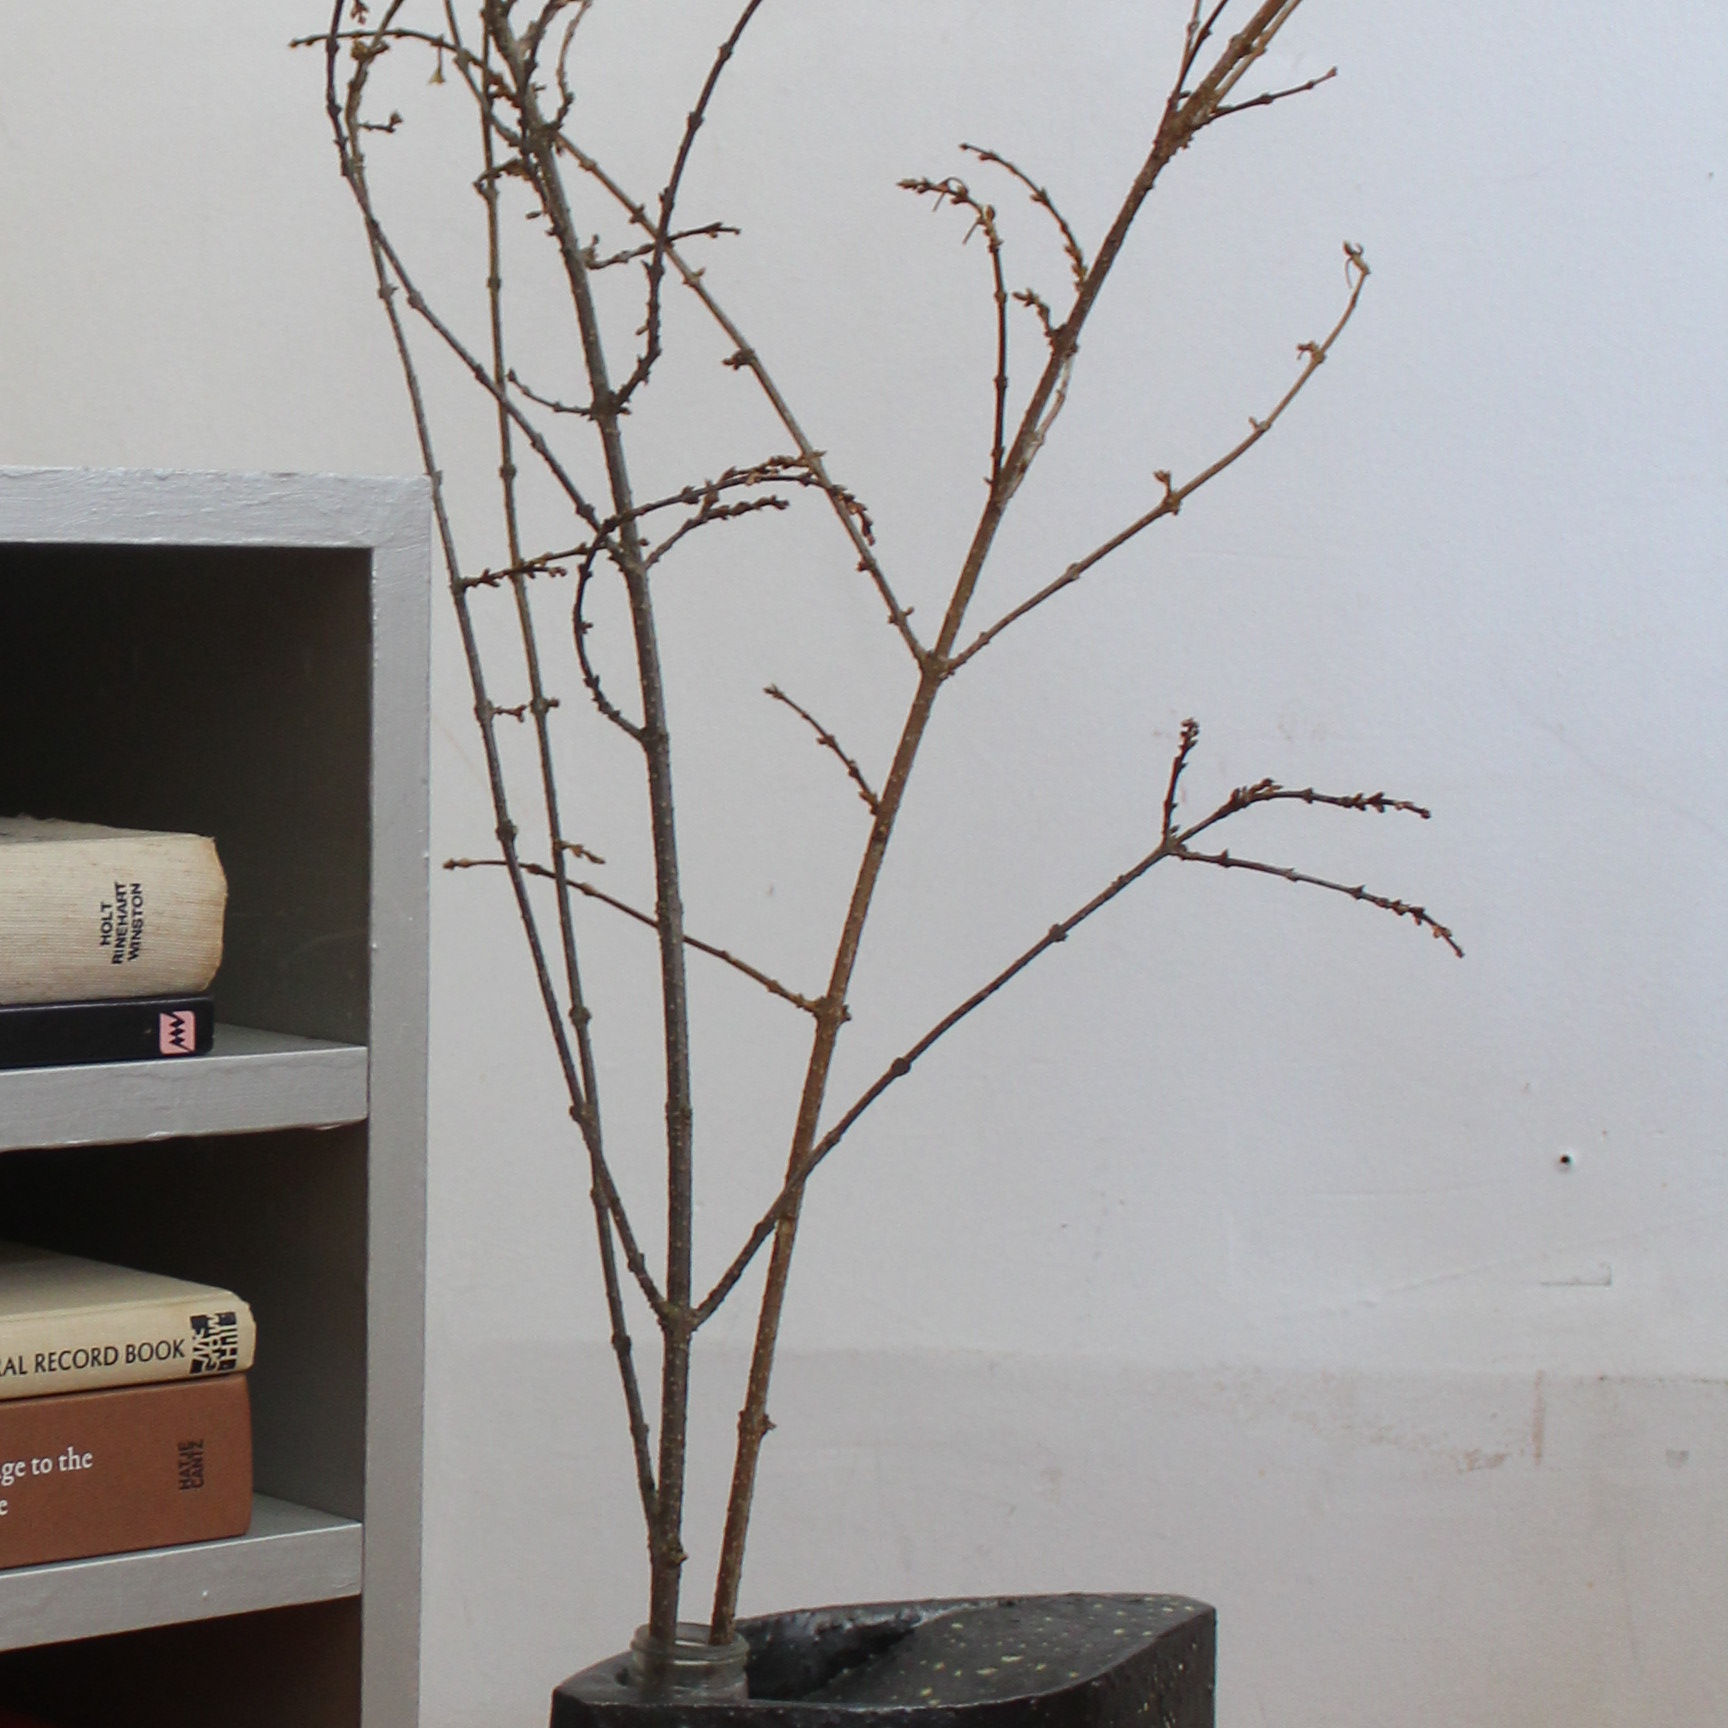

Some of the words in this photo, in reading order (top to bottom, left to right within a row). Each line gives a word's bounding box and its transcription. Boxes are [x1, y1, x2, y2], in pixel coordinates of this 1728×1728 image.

[100, 901, 113, 946] HOLT
[112, 881, 128, 965] RINEHART
[127, 883, 144, 961] WINSTON
[33, 1345, 120, 1375] RECORD
[124, 1337, 187, 1365] BOOK
[31, 1453, 55, 1476] to
[58, 1447, 94, 1473] the
